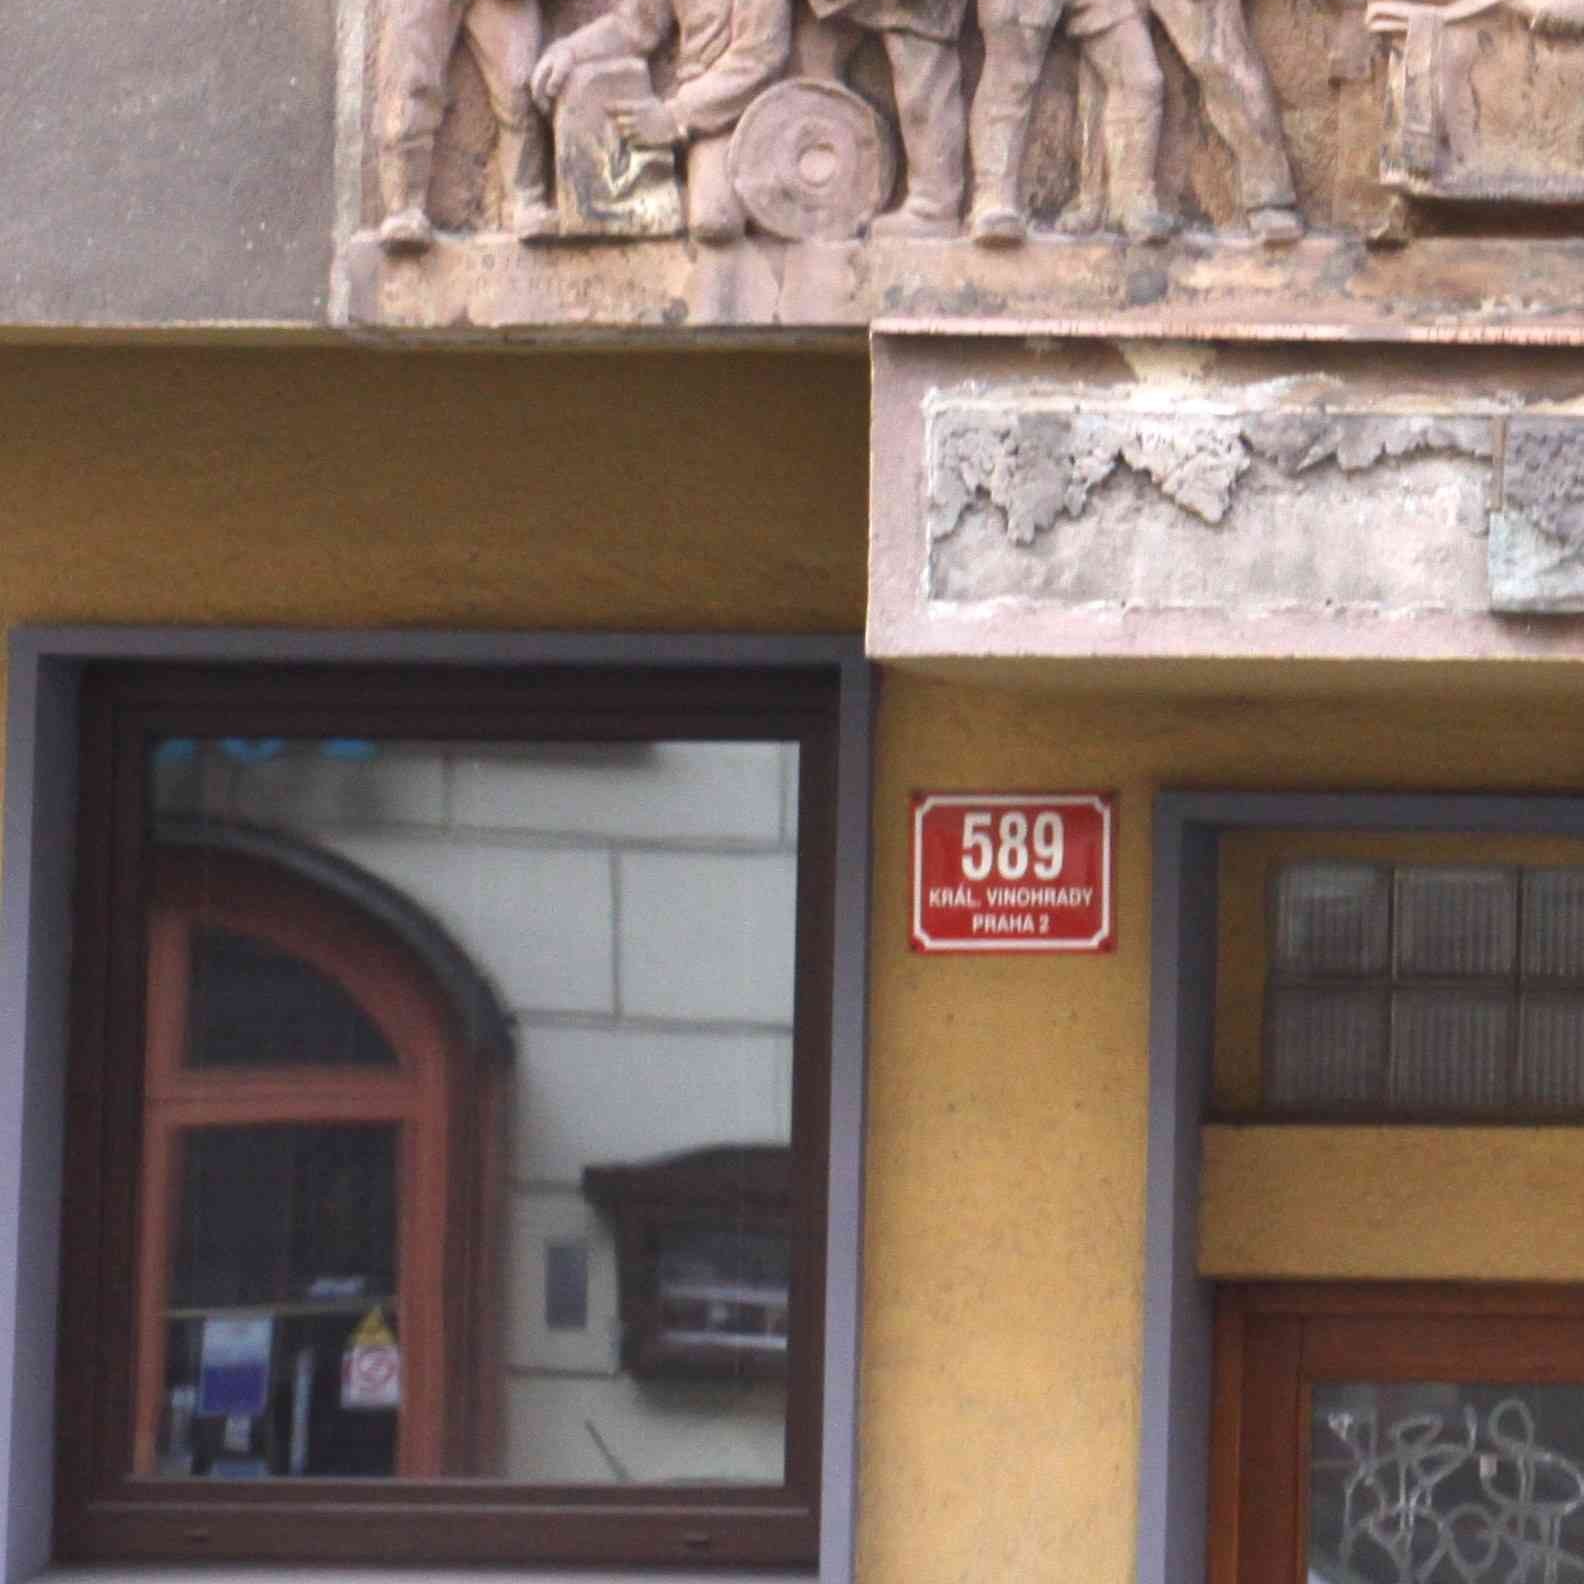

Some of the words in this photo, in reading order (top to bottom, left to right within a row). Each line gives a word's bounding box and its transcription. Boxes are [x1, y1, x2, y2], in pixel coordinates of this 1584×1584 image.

[961, 811, 1065, 881] 589
[929, 882, 982, 908] KRÁL.
[986, 887, 1094, 908] VINOHRADY
[972, 914, 1035, 934] PRAHA
[1039, 914, 1051, 934] 2
